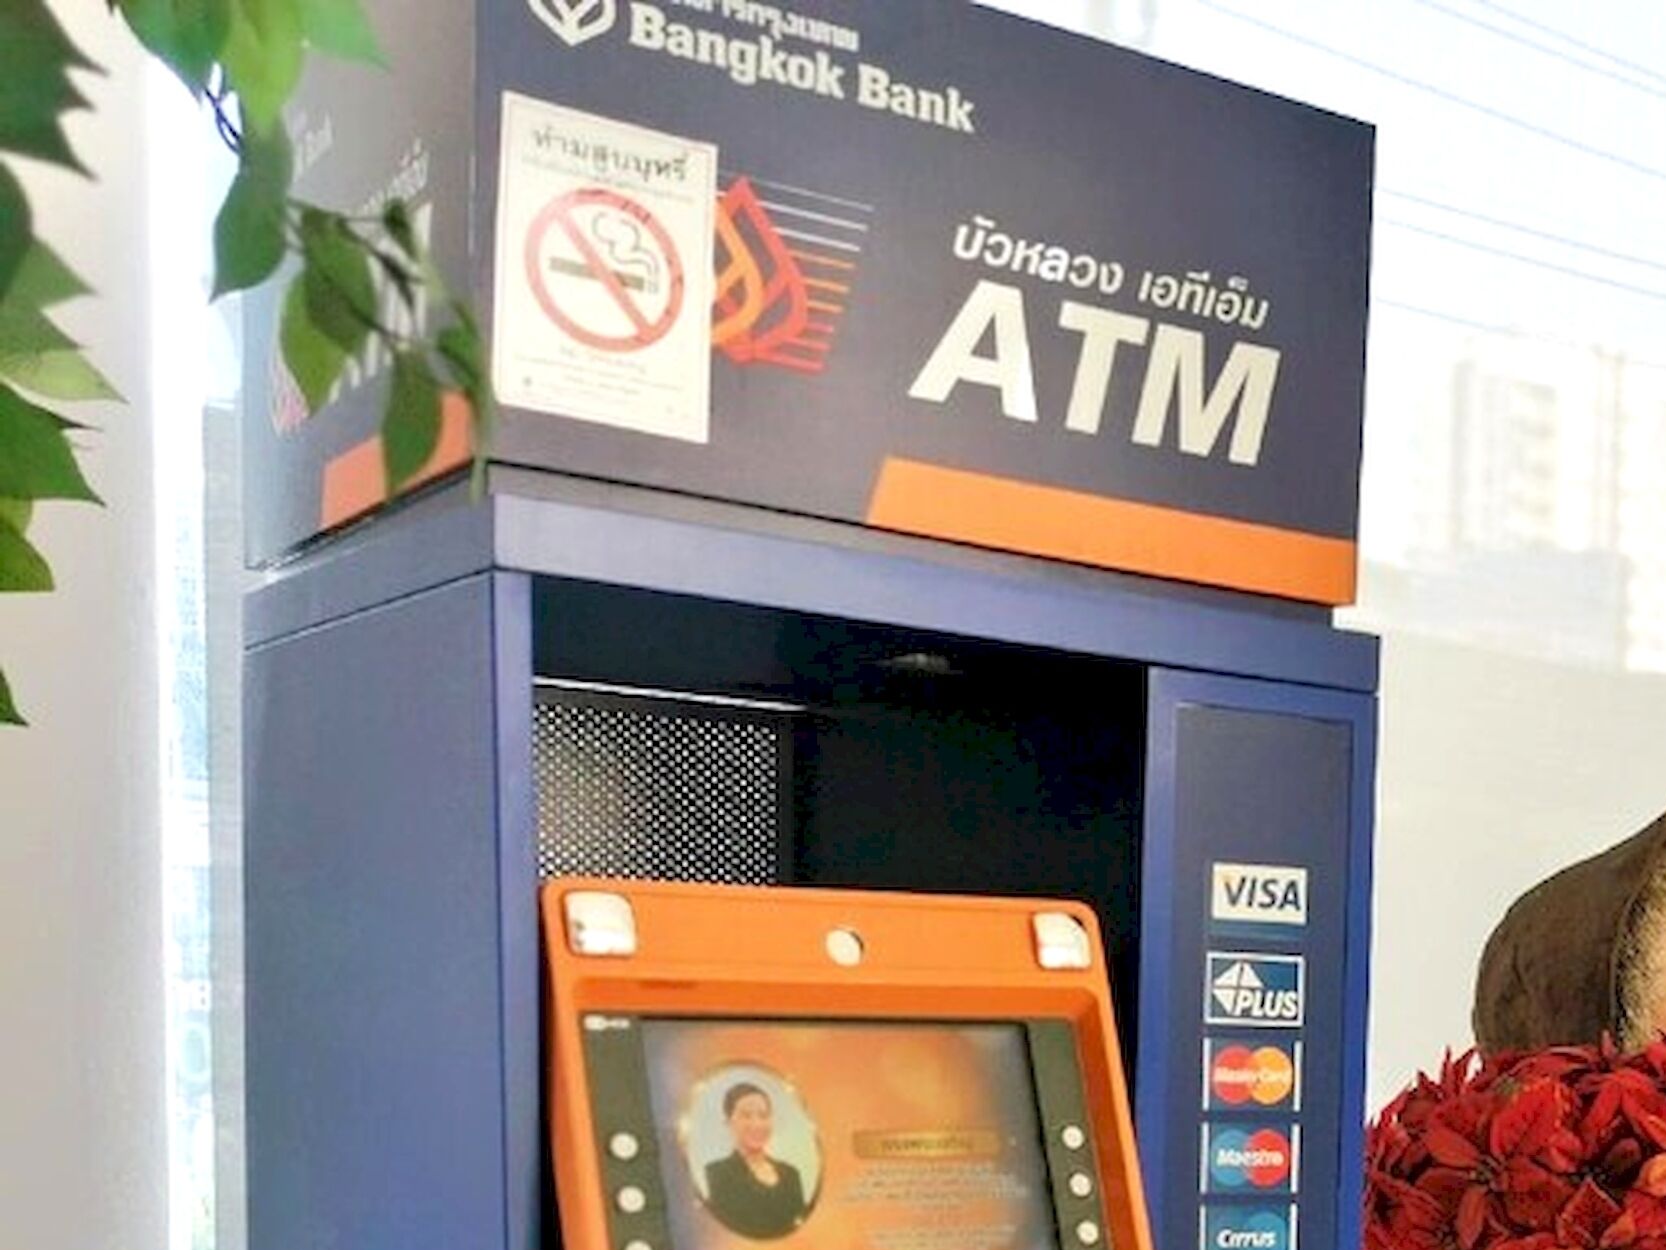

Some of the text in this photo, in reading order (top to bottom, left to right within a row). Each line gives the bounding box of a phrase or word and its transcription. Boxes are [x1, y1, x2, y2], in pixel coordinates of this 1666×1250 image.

[628, 3, 976, 133] Bangkok Bank
[952, 215, 1270, 331] บัวหลวง เอทีเอ็ม
[906, 277, 1283, 468] ATM
[1223, 875, 1301, 912] VISA
[1233, 988, 1298, 1019] PLUS
[1216, 1148, 1285, 1168] Maestro
[1216, 1228, 1277, 1249] Cirrus
